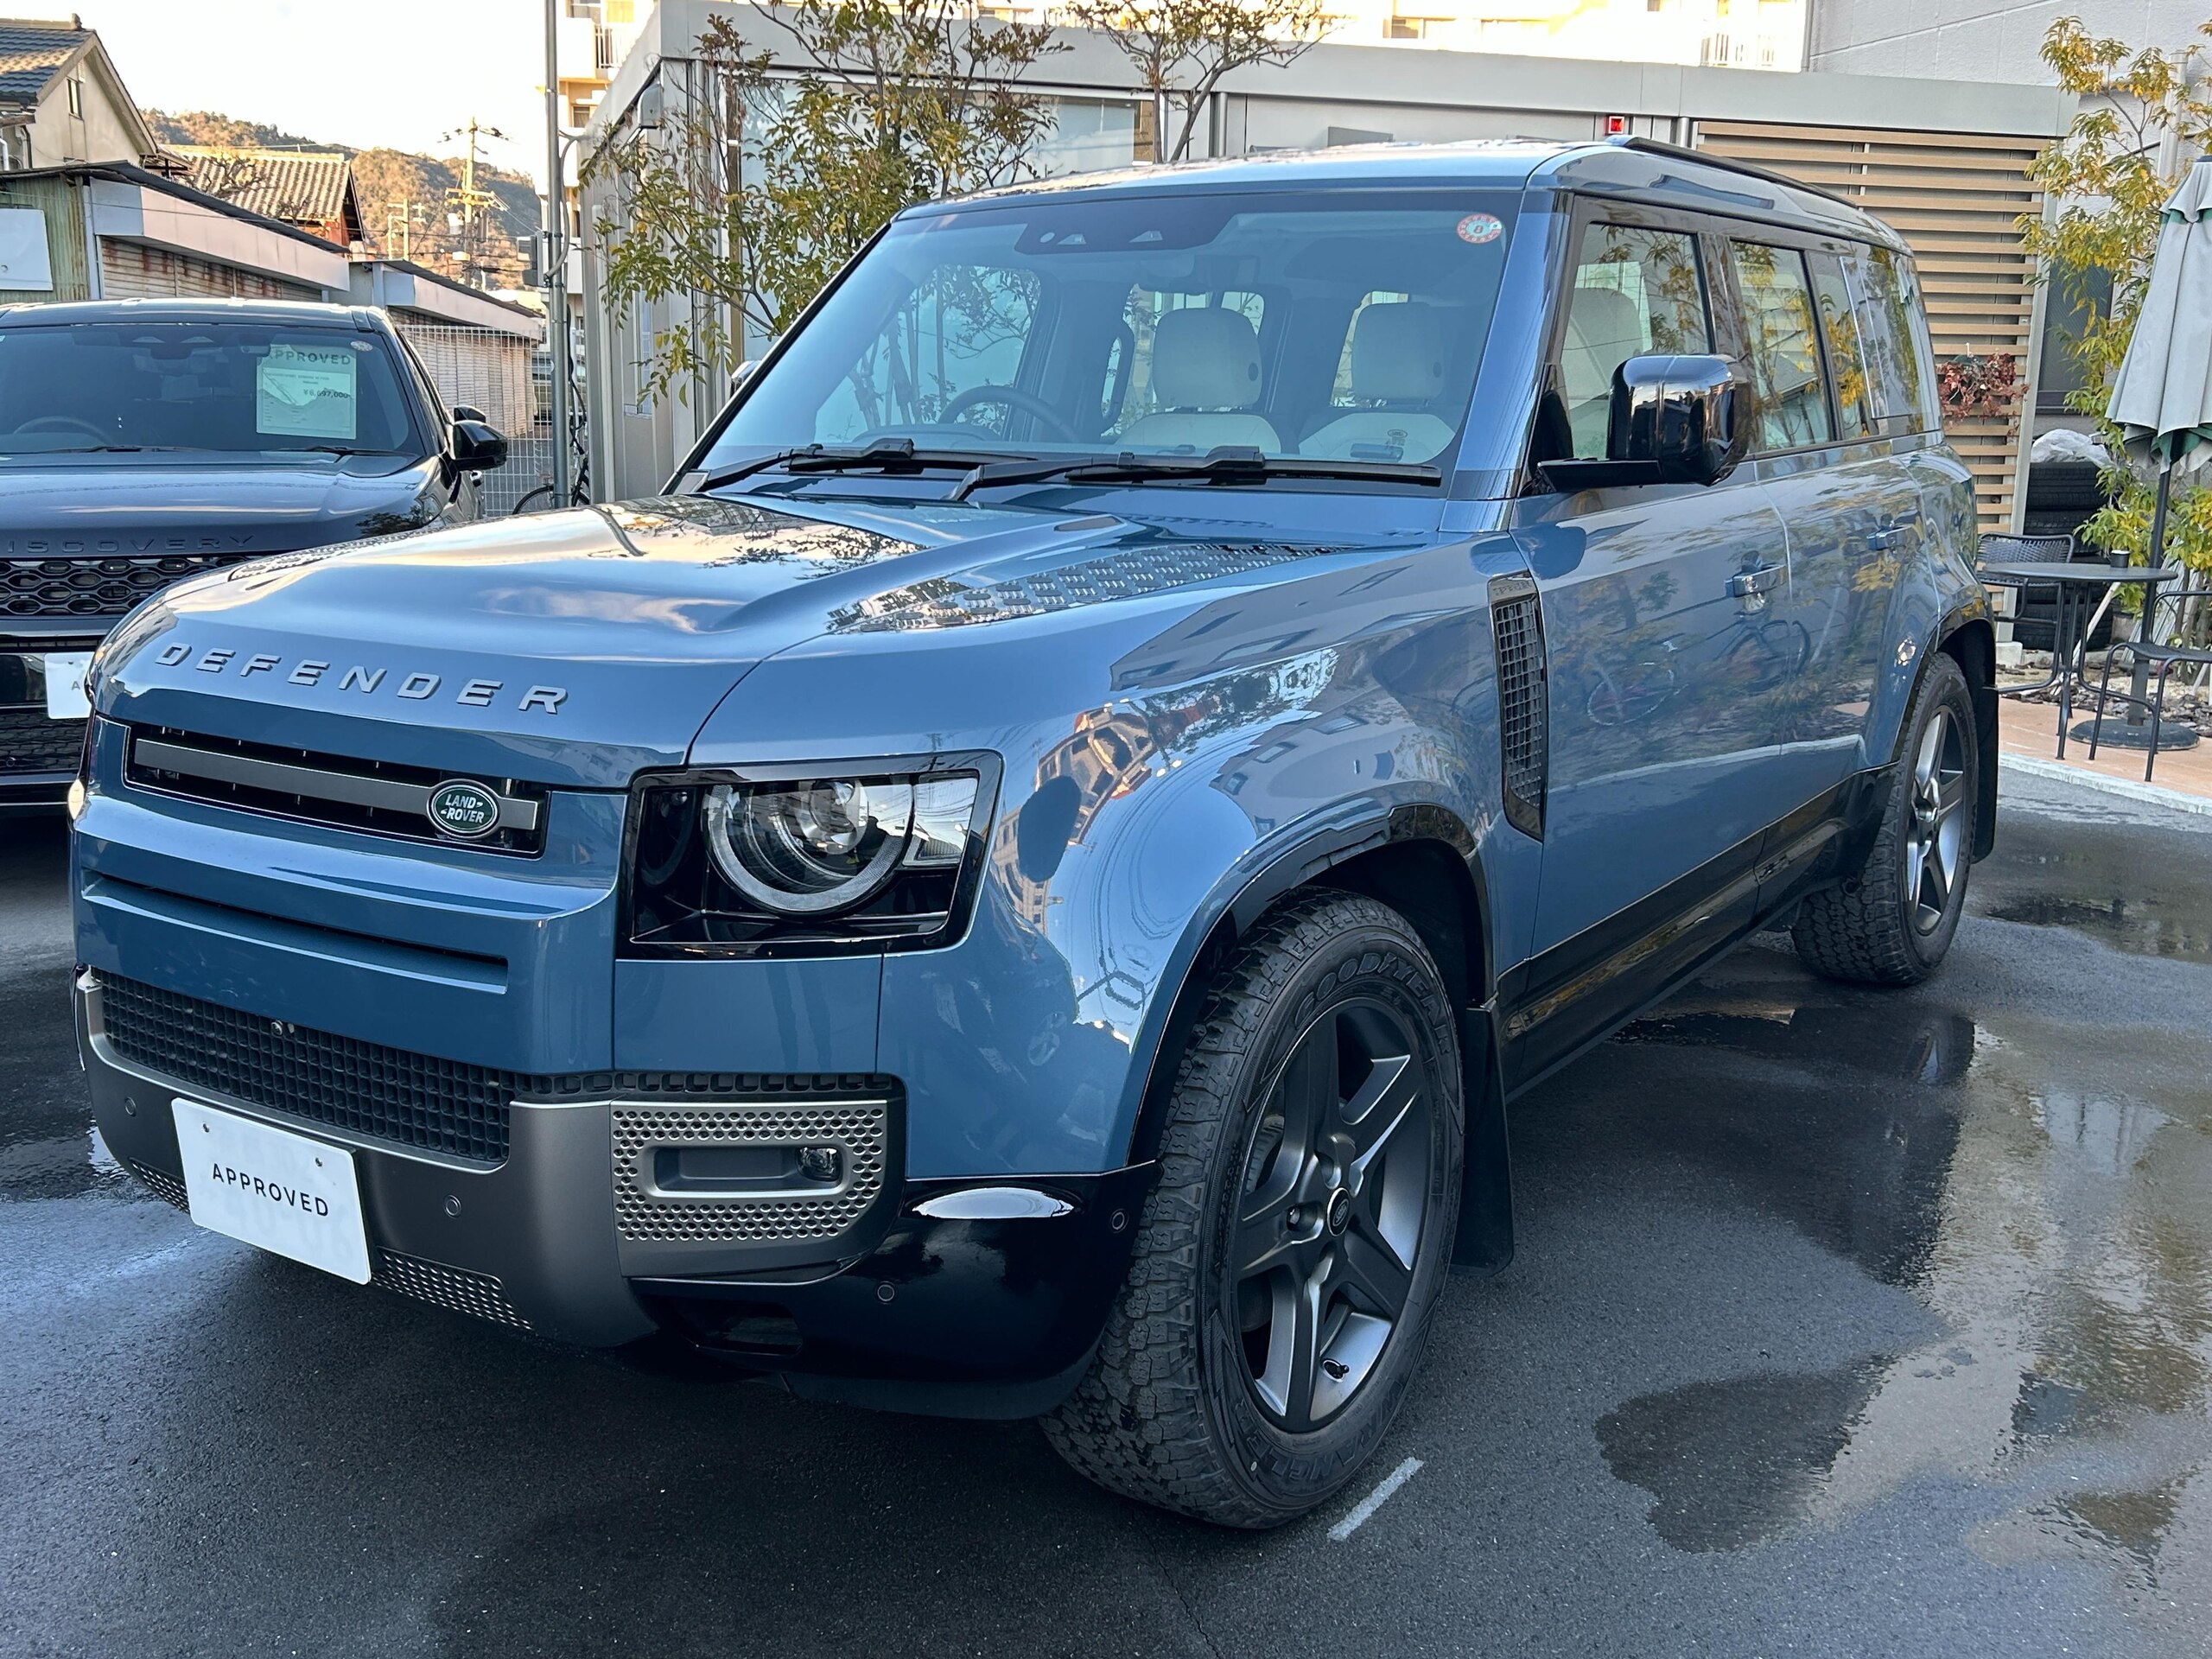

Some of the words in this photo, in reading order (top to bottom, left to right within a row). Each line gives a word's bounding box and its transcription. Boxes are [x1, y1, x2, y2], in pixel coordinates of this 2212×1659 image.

[6, 535, 254, 553] ISCOVERY
[154, 642, 569, 715] DEFENDER
[445, 794, 477, 809] LAND
[446, 807, 485, 823] ROVER
[1295, 952, 1452, 1055] GOODYEAR
[213, 1162, 329, 1217] APPROVED
